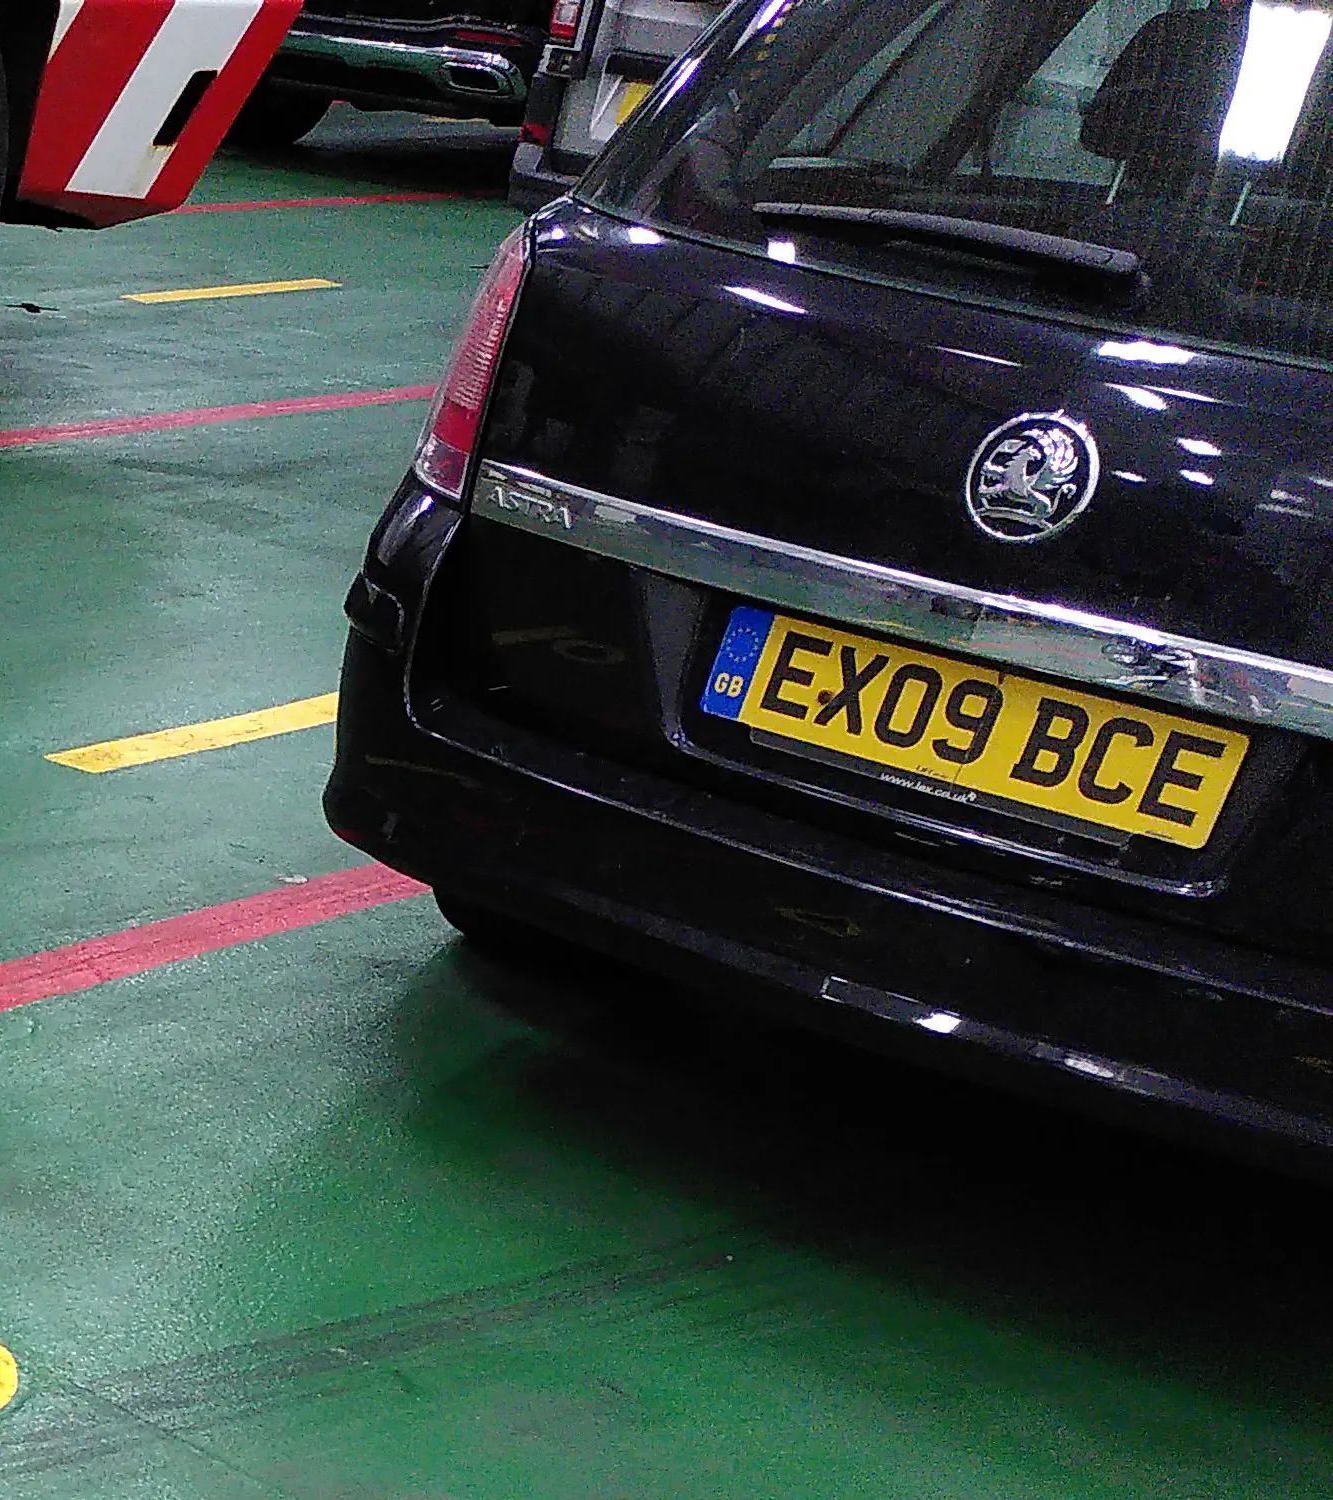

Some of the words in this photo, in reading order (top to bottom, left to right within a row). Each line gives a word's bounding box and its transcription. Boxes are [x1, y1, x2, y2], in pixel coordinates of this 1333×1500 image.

[487, 486, 573, 529] ASTRA
[715, 672, 744, 697] GB
[759, 630, 1004, 764] EX09
[1010, 697, 1227, 827] BCE
